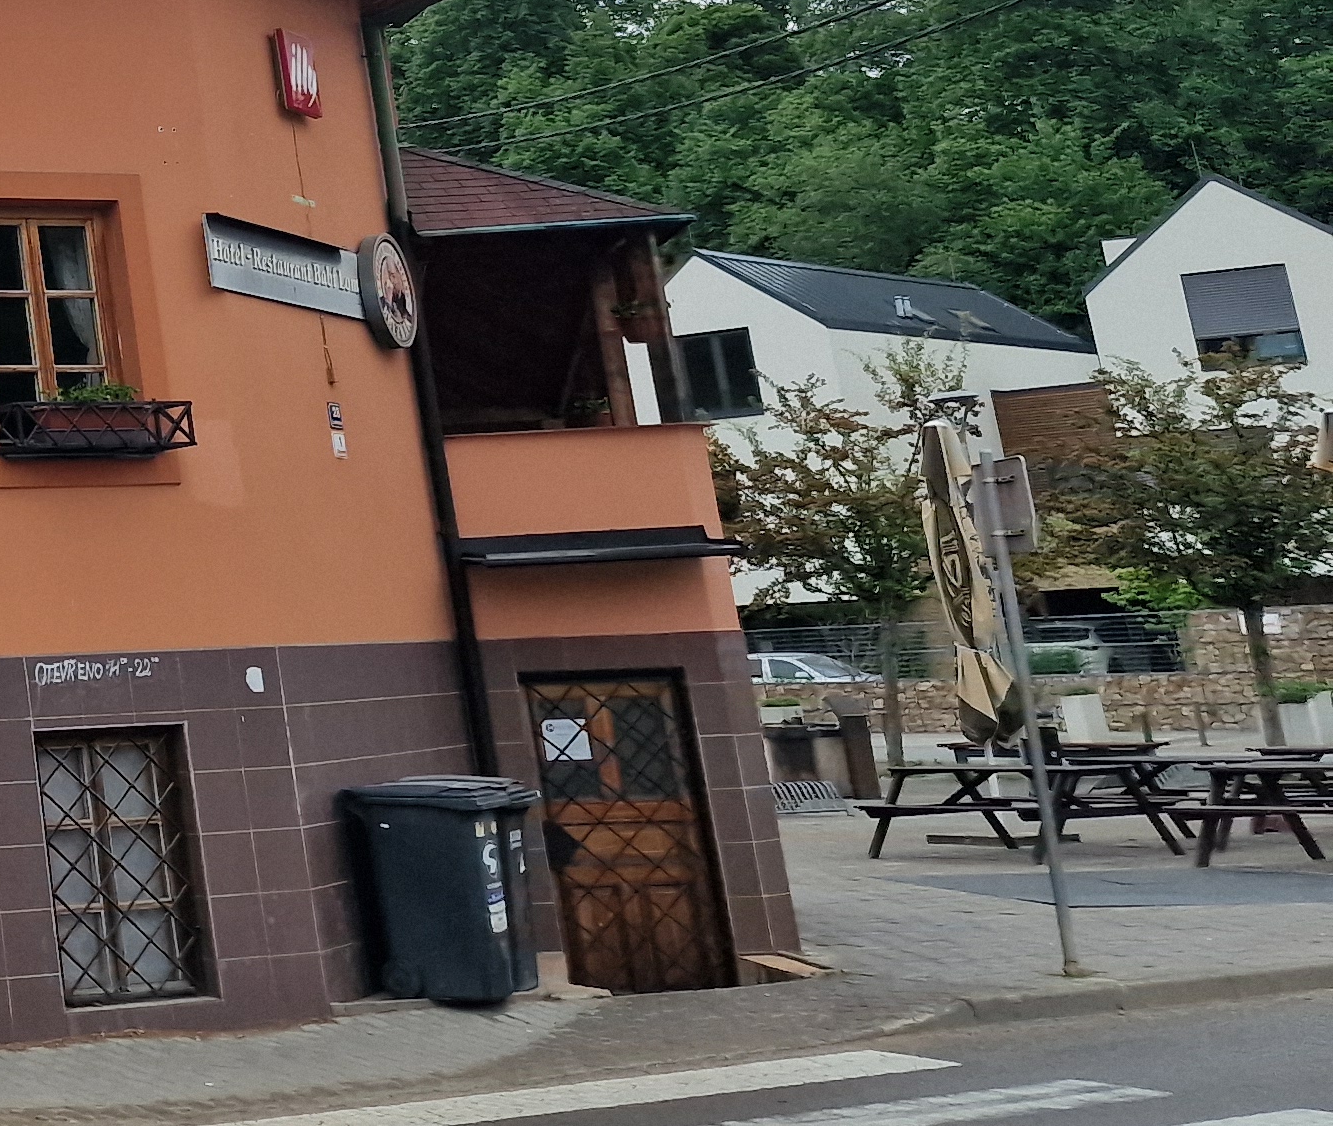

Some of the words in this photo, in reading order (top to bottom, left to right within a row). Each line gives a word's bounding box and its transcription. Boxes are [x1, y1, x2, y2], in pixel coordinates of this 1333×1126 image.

[291, 43, 317, 107] illy
[212, 237, 245, 267] Hotel
[252, 247, 313, 284] Restaurant
[313, 262, 338, 289] Babí
